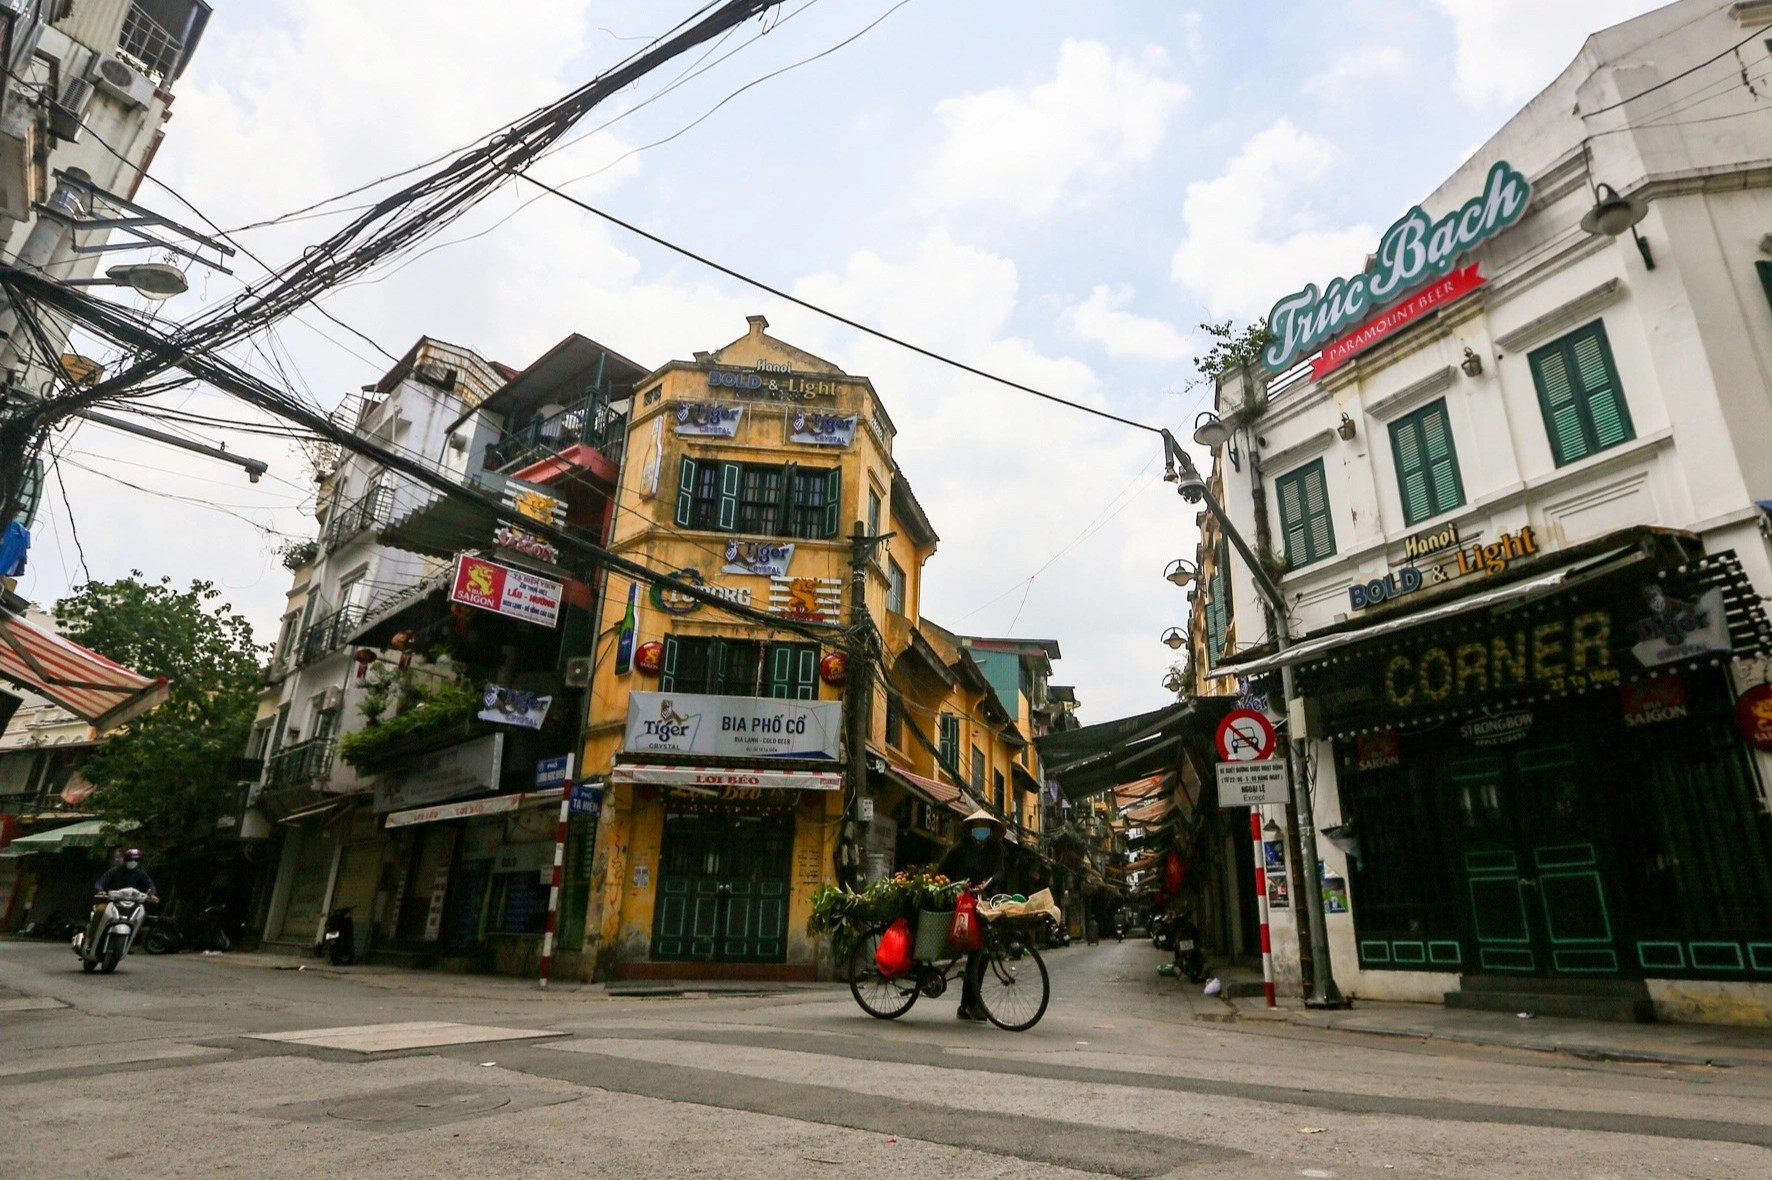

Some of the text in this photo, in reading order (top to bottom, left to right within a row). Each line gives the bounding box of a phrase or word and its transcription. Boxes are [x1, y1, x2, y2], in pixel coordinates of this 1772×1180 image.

[1267, 168, 1523, 366] Trúc Bạch
[1329, 280, 1456, 361] PARAMOUNT BEER
[756, 358, 792, 375] Hanoi
[708, 371, 836, 400] BOLD & Light
[694, 402, 740, 425] Tiger
[813, 413, 854, 435] Tiger
[700, 425, 732, 436] CRYSTAL
[815, 434, 846, 444] CRYSTAL
[1404, 521, 1459, 559] Hanoi
[745, 541, 790, 564] Tiger
[1348, 525, 1541, 612] BOLD & Light
[456, 589, 495, 608] SAIGON
[1385, 610, 1613, 708] CORNER
[722, 713, 808, 735] BIA PHỐ CỔ
[1460, 712, 1534, 739] STRONGBOW
[1624, 704, 1688, 727] SAIGON
[643, 719, 690, 743] Tiger
[648, 742, 681, 752] CRYSTAL
[1359, 755, 1400, 771] SAIGON
[1243, 793, 1266, 803] Except
